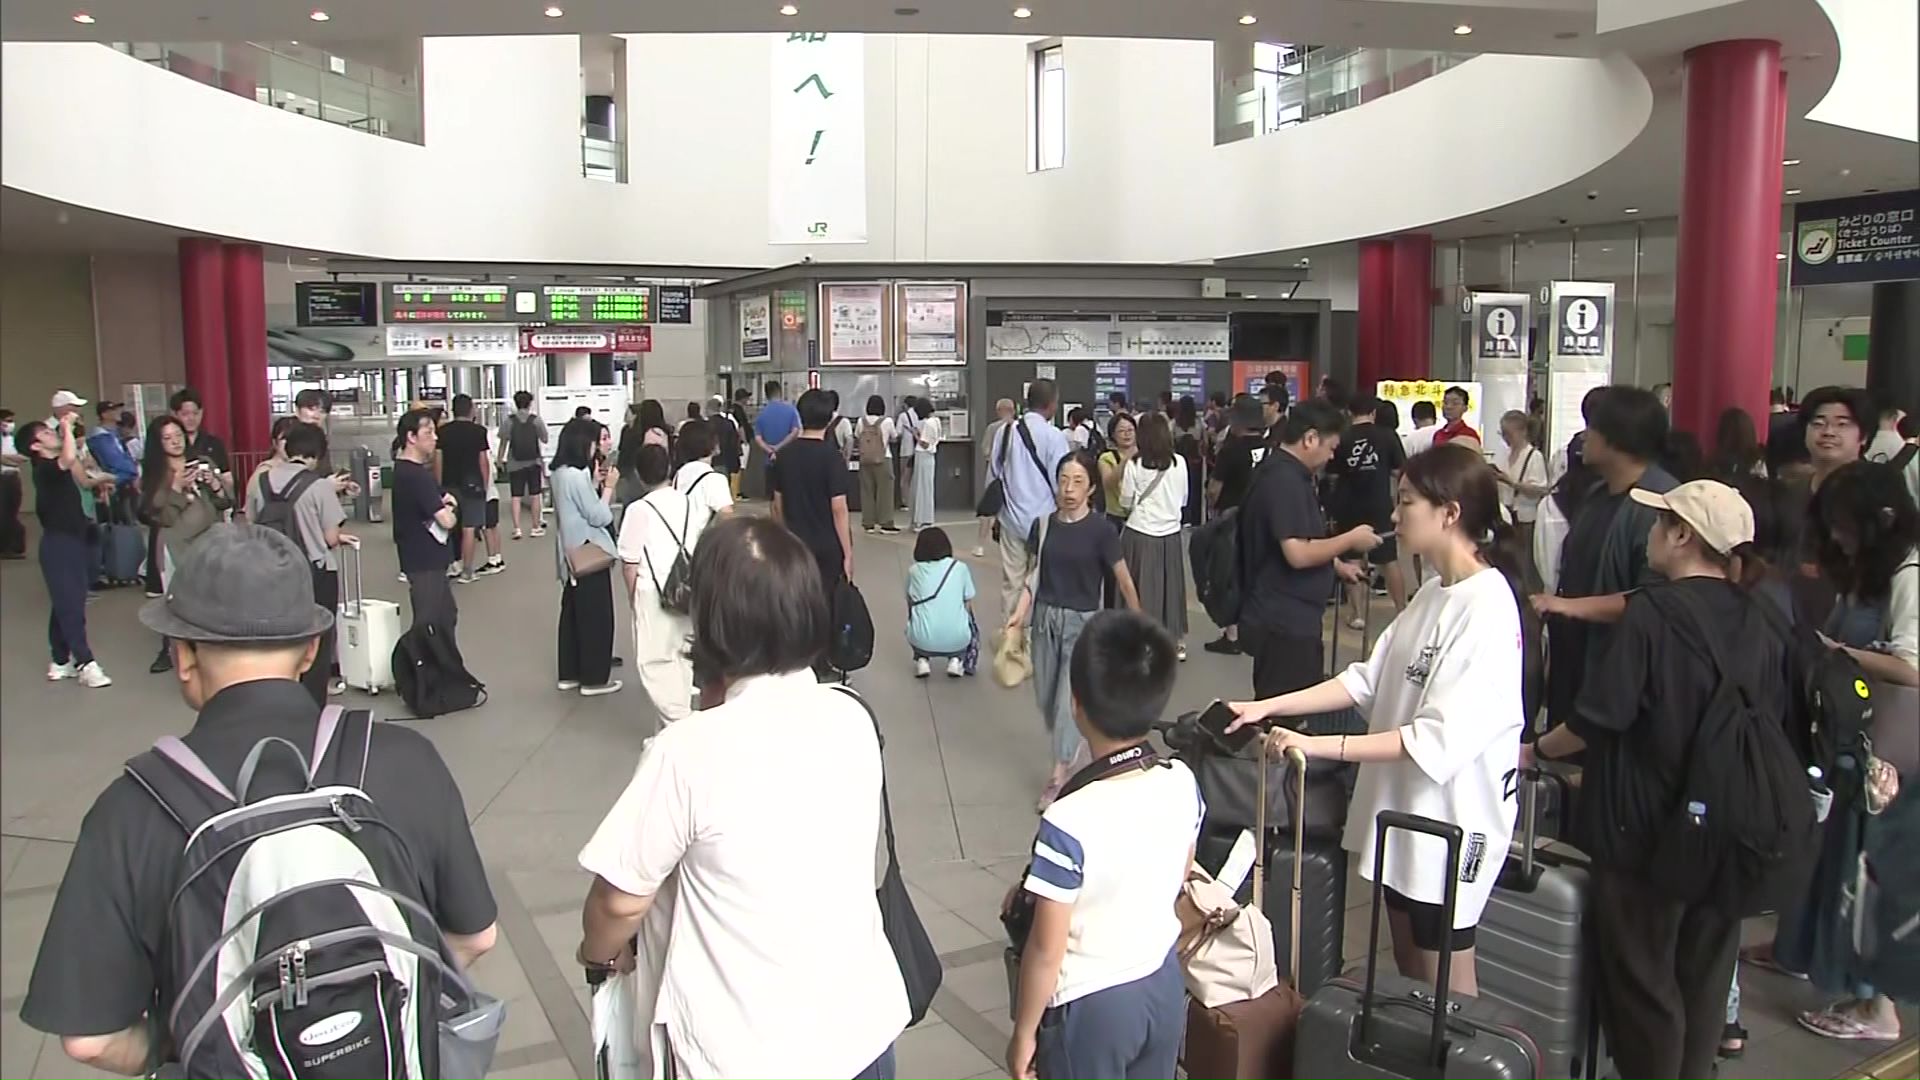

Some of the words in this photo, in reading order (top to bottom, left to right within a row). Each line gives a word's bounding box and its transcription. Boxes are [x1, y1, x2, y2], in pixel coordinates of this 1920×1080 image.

[1838, 209, 1914, 227] みどりの窓口
[807, 222, 827, 233] JR
[1837, 240, 1867, 249] Ticket
[1870, 235, 1913, 246] Counter
[1384, 383, 1441, 396] 特急北斗
[1109, 746, 1143, 765] Canon
[303, 1015, 359, 1042] deuter
[303, 1036, 372, 1068] SUPERBIKE
